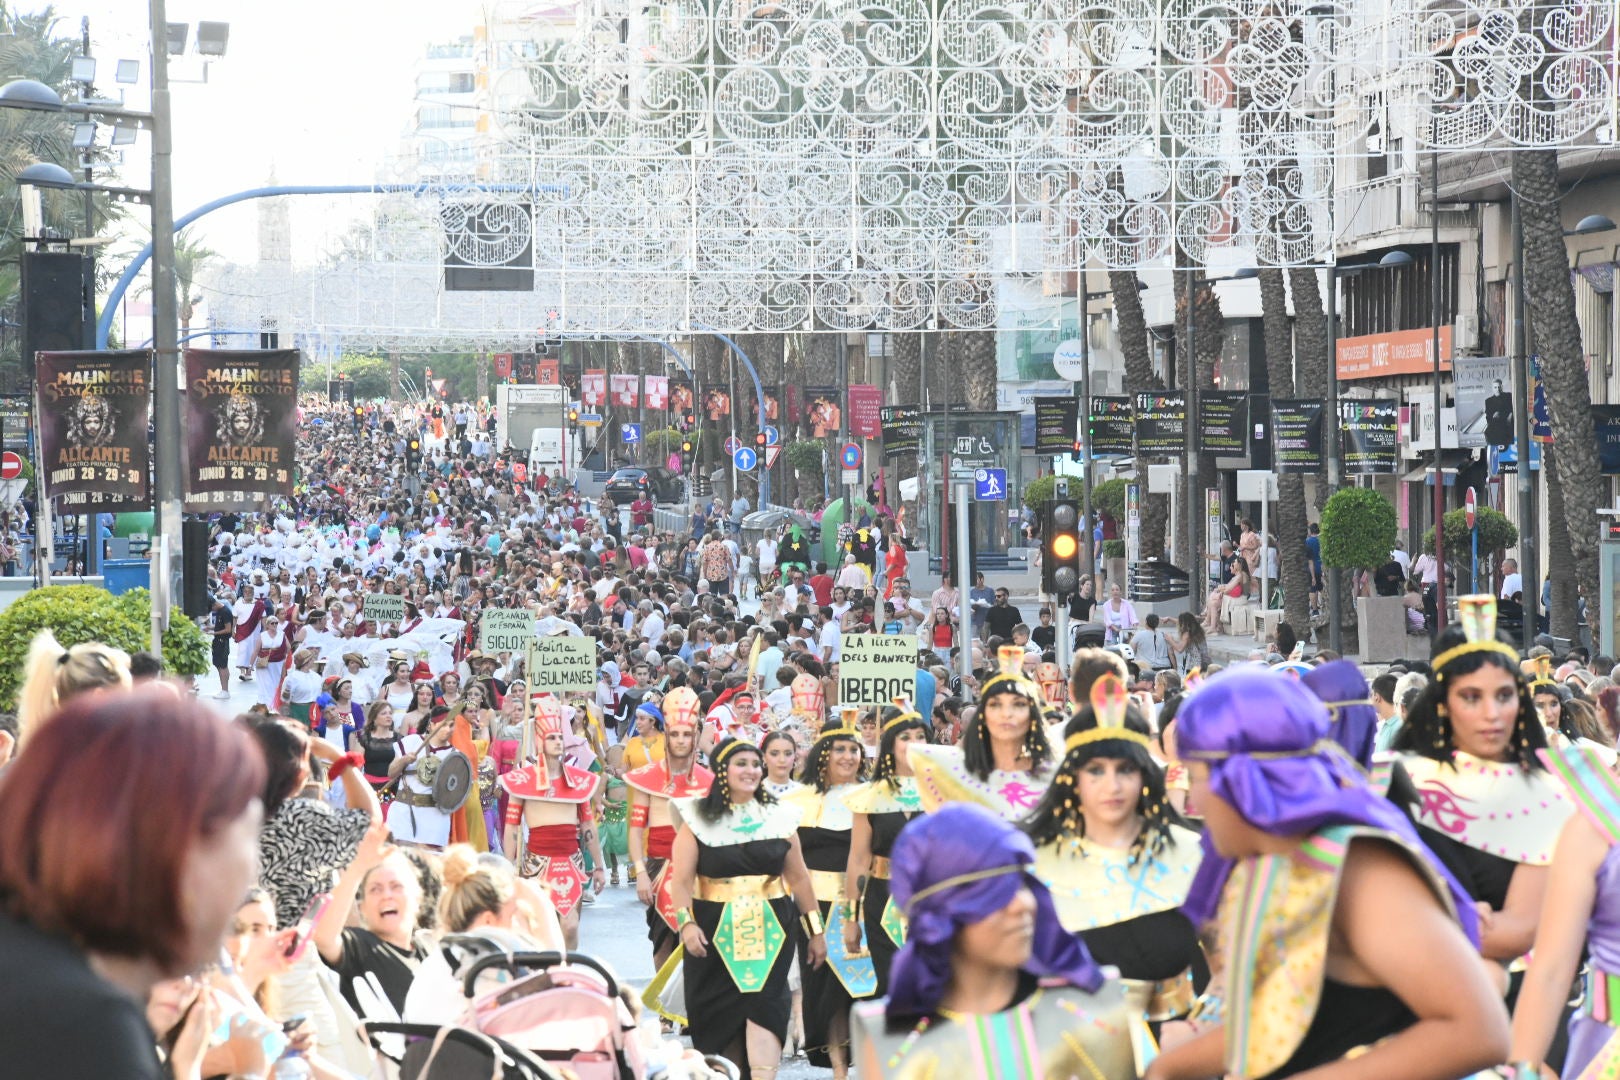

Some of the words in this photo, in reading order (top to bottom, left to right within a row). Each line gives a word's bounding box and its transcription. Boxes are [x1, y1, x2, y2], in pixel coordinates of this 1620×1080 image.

[57, 369, 144, 386] MALINCHE
[206, 368, 292, 384] MALINCHE
[59, 446, 130, 464] ALICANTE
[208, 445, 279, 462] ALICANTE
[90, 461, 121, 469] PRINCIPAL
[240, 460, 269, 468] PRINCIPAL
[51, 468, 75, 485] JUNIO
[81, 467, 95, 480] 28
[105, 467, 119, 481] 29
[128, 469, 140, 483] 30
[199, 466, 226, 481] JUNIO
[231, 466, 244, 480] 28
[254, 467, 267, 481] 29
[276, 468, 288, 483] 30
[91, 491, 104, 503] 28
[213, 490, 225, 502] 28
[233, 490, 244, 502] 29
[252, 491, 264, 502] 30
[363, 607, 403, 620] ROMANOS
[499, 620, 526, 630] ESPAÑA
[487, 635, 518, 650] SIGLO
[845, 636, 863, 648] LA
[542, 652, 590, 666] Lacant
[842, 653, 867, 663] DELS
[873, 653, 916, 664] BANYETS
[841, 677, 914, 703] IBEROS
